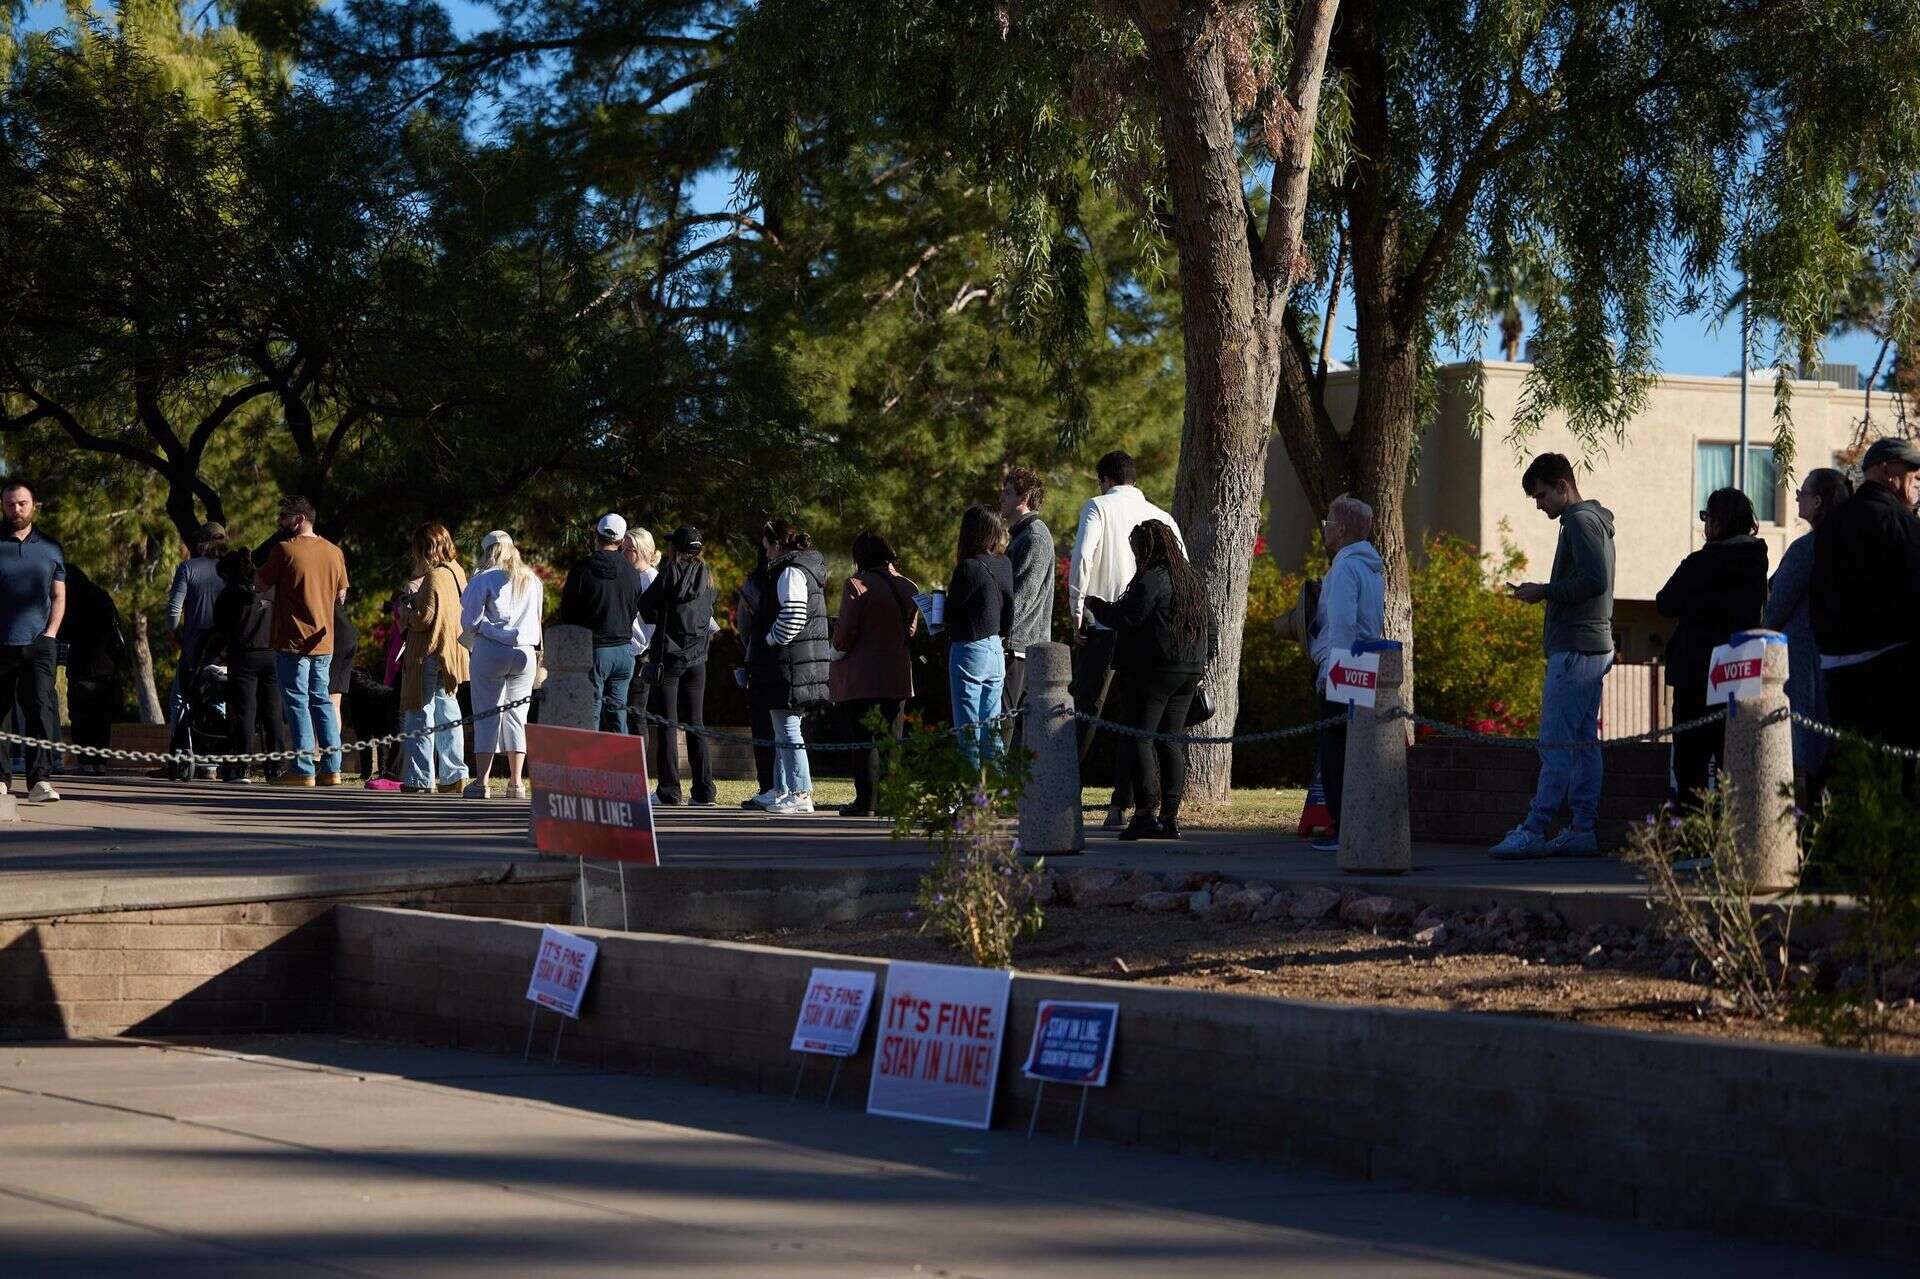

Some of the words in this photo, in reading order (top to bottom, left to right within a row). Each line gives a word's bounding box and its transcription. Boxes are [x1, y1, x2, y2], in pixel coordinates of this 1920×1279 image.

[1344, 669, 1369, 686] VOTE
[1723, 661, 1752, 679] VOTE
[548, 793, 577, 820] STAY
[581, 797, 595, 822] IN
[599, 799, 633, 827] LINE!
[887, 995, 931, 1033] IT'S
[936, 1003, 995, 1040] FINE.
[880, 1036, 921, 1079] STAY
[922, 1041, 942, 1081] IN
[944, 1043, 992, 1089] LINE!
